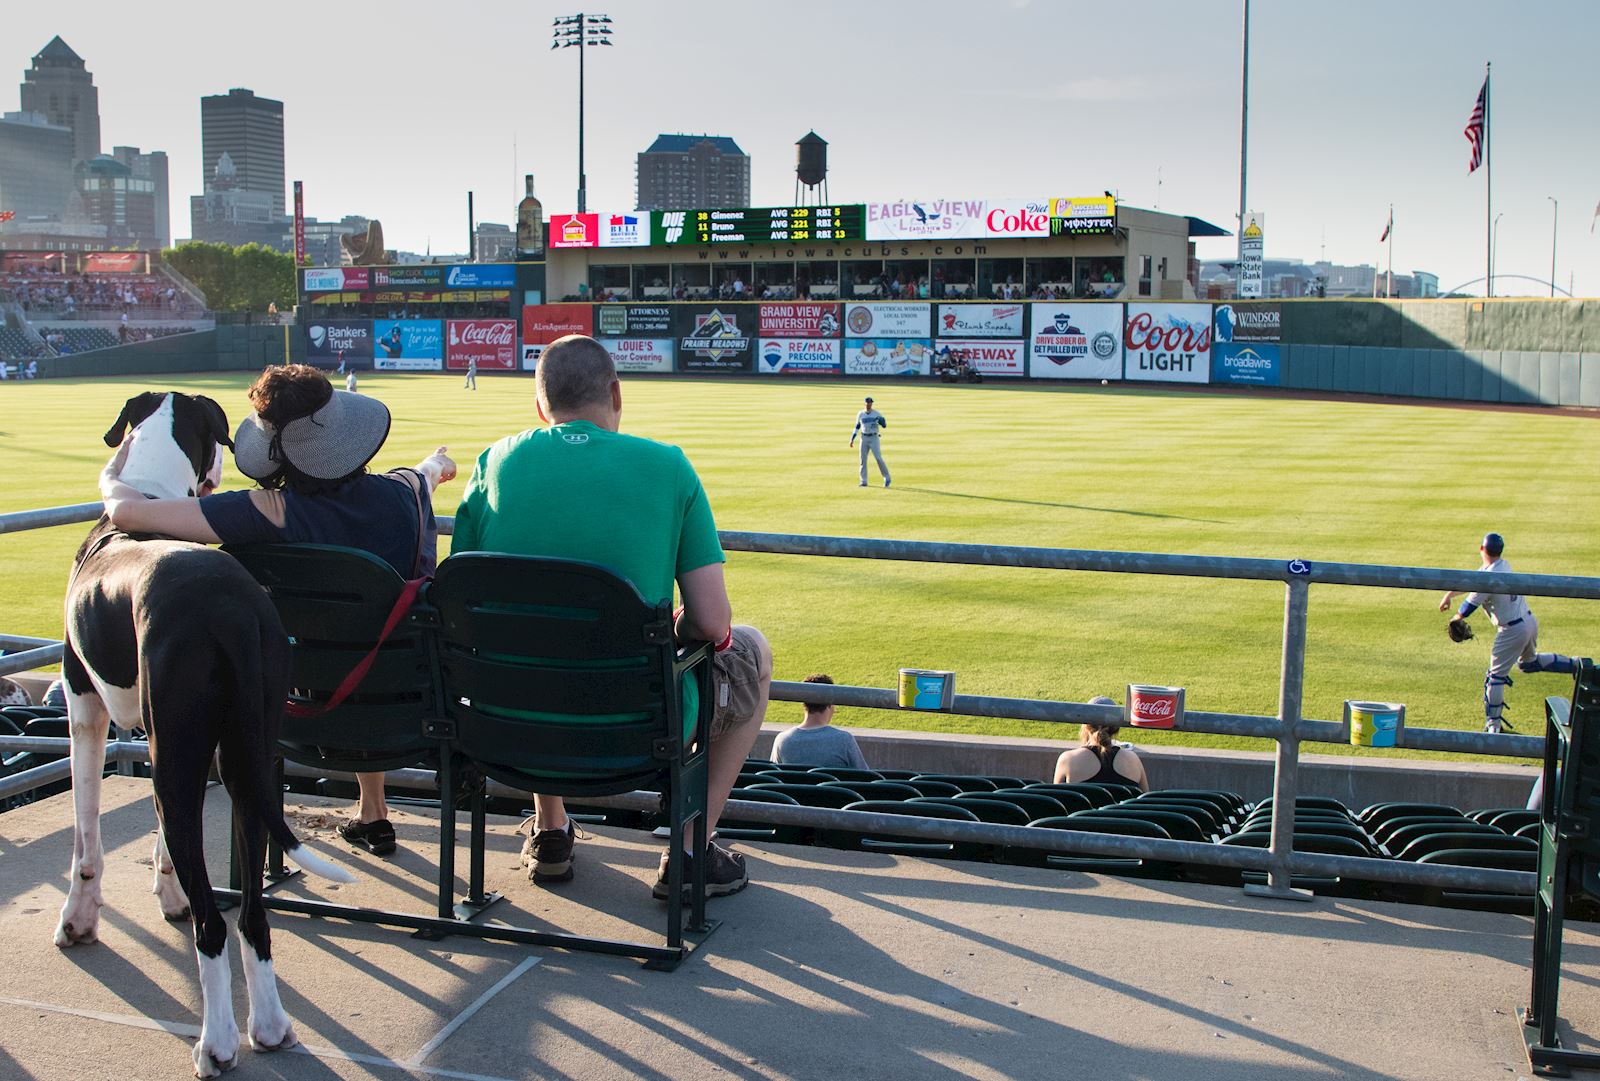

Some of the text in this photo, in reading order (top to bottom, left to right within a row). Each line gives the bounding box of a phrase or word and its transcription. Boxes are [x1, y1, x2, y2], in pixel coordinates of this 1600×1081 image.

[711, 212, 744, 220] Gimenez
[770, 210, 788, 218] AVG
[791, 209, 808, 217] .229
[816, 208, 832, 216] RBI
[834, 208, 840, 216] 5
[868, 202, 983, 222] EAGL VIEW
[1026, 203, 1048, 214] Diet
[662, 212, 686, 228] DUE
[698, 219, 841, 231] 11 Bruno AVG .221 RBI 4
[986, 207, 1048, 232] Coke
[1064, 218, 1113, 228] MONSTER
[665, 228, 683, 243] UP
[712, 233, 744, 241] Freeman
[770, 231, 788, 239] AVG
[791, 231, 808, 239] .254
[816, 230, 832, 238] RBI
[834, 230, 845, 238] 13
[1242, 254, 1261, 262] Iowa
[1242, 263, 1262, 271] State
[1242, 272, 1261, 280] Bank
[760, 306, 821, 317] GRAND VIEW
[762, 318, 819, 329] UNIVERSITY
[955, 320, 1014, 331] Plumb Supply
[1238, 312, 1280, 328] WINDSOR
[328, 326, 367, 338] Bankers
[1126, 312, 1210, 352] Coors
[329, 338, 352, 349] Trust
[408, 333, 421, 347] for
[684, 340, 745, 348] PRAIRIE MEADOWS
[1056, 337, 1076, 345] SOBER
[1078, 337, 1086, 345] OR
[618, 341, 653, 351] LOUIE'S
[789, 343, 832, 352] RE/MAX
[1034, 345, 1046, 353] GET
[1072, 346, 1087, 354] OVER
[630, 353, 662, 363] Covering
[789, 353, 832, 361] PRECISION
[1140, 353, 1195, 371] LIGHT
[1224, 354, 1271, 369] broadlawns
[1132, 698, 1173, 716] Coca-Cola
